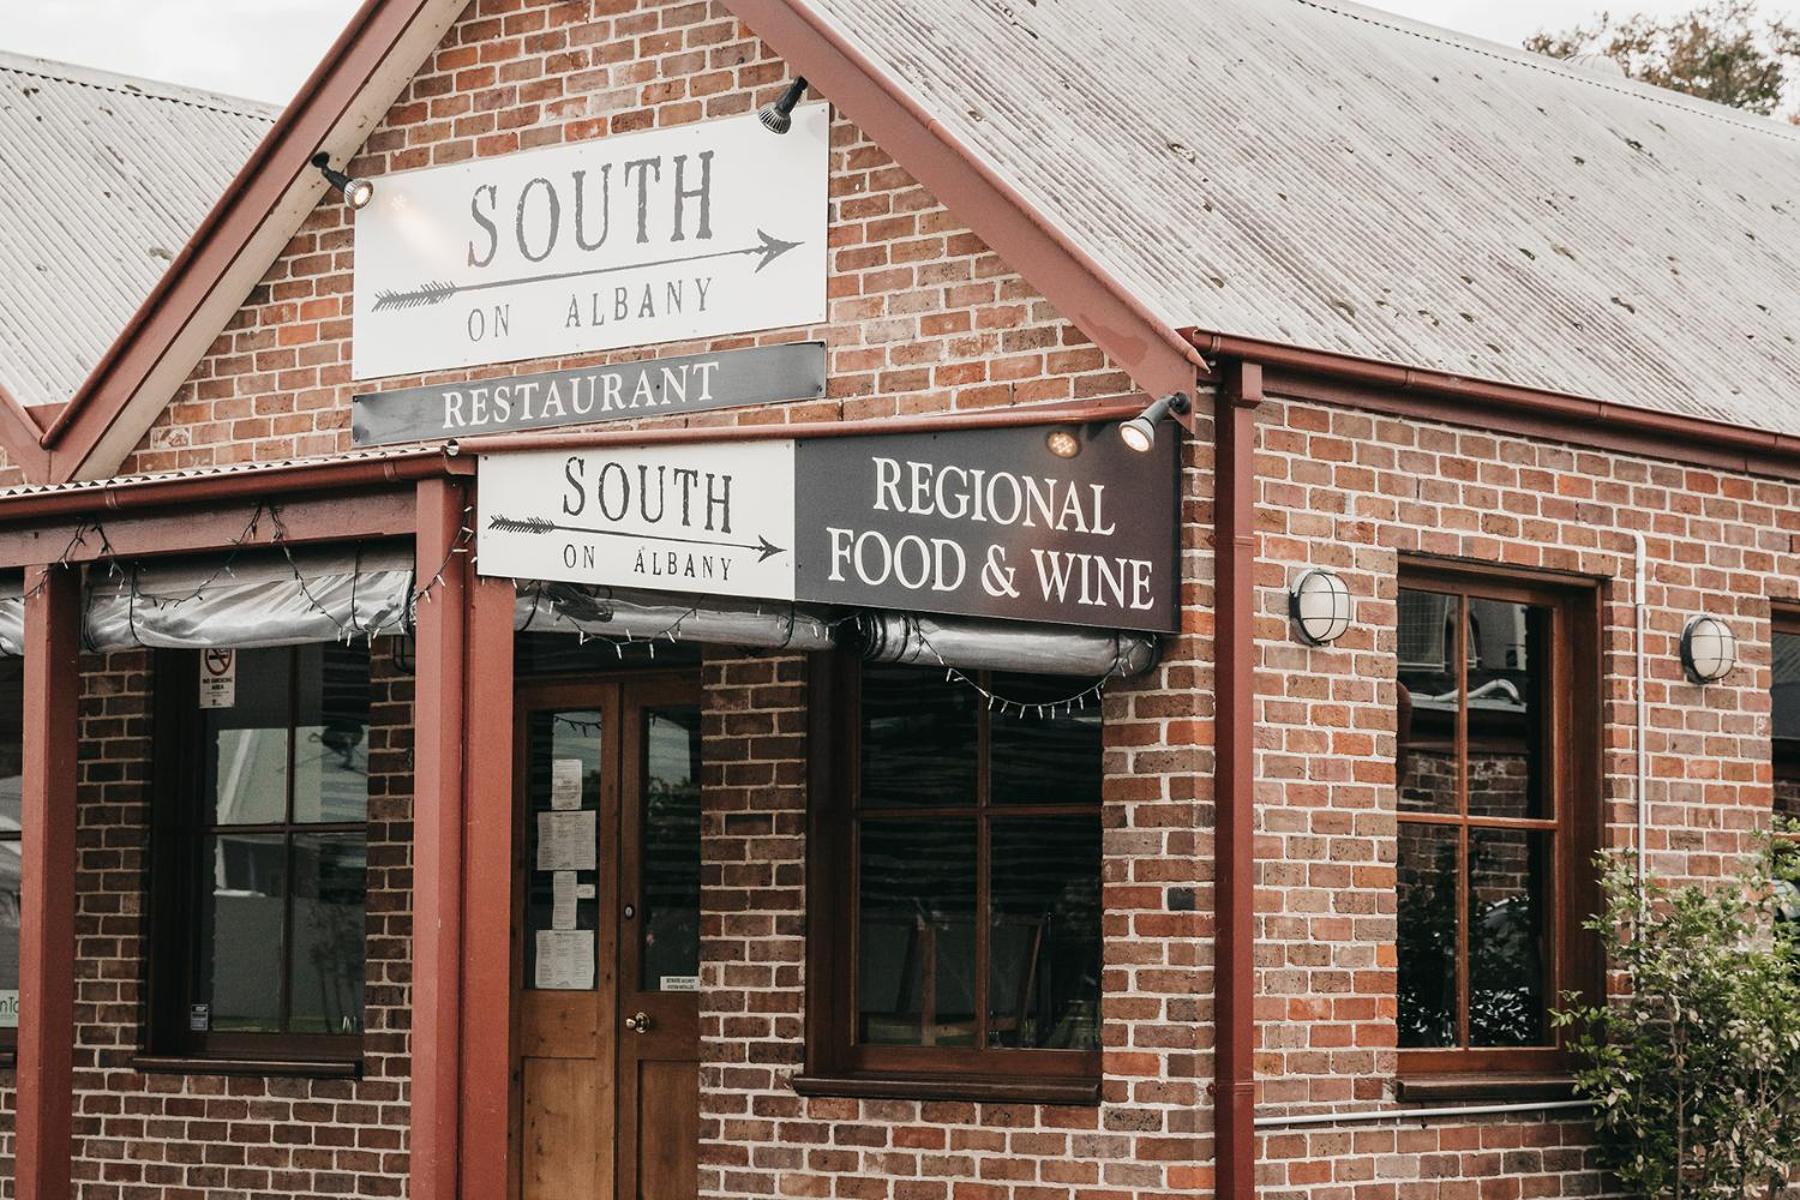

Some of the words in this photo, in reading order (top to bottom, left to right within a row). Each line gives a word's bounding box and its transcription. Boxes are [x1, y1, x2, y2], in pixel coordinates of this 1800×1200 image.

[468, 150, 714, 267] SOUTH
[467, 304, 510, 342] ON
[566, 278, 712, 329] ALBANY
[442, 362, 719, 429] RESTAURANT
[562, 457, 732, 533] SOUTH
[872, 457, 1116, 536] REGIONAL
[563, 543, 594, 569] ON
[633, 550, 732, 581] ALBANY
[827, 527, 966, 592] FOOD
[981, 544, 1020, 598] &
[1031, 549, 1154, 610] WINE
